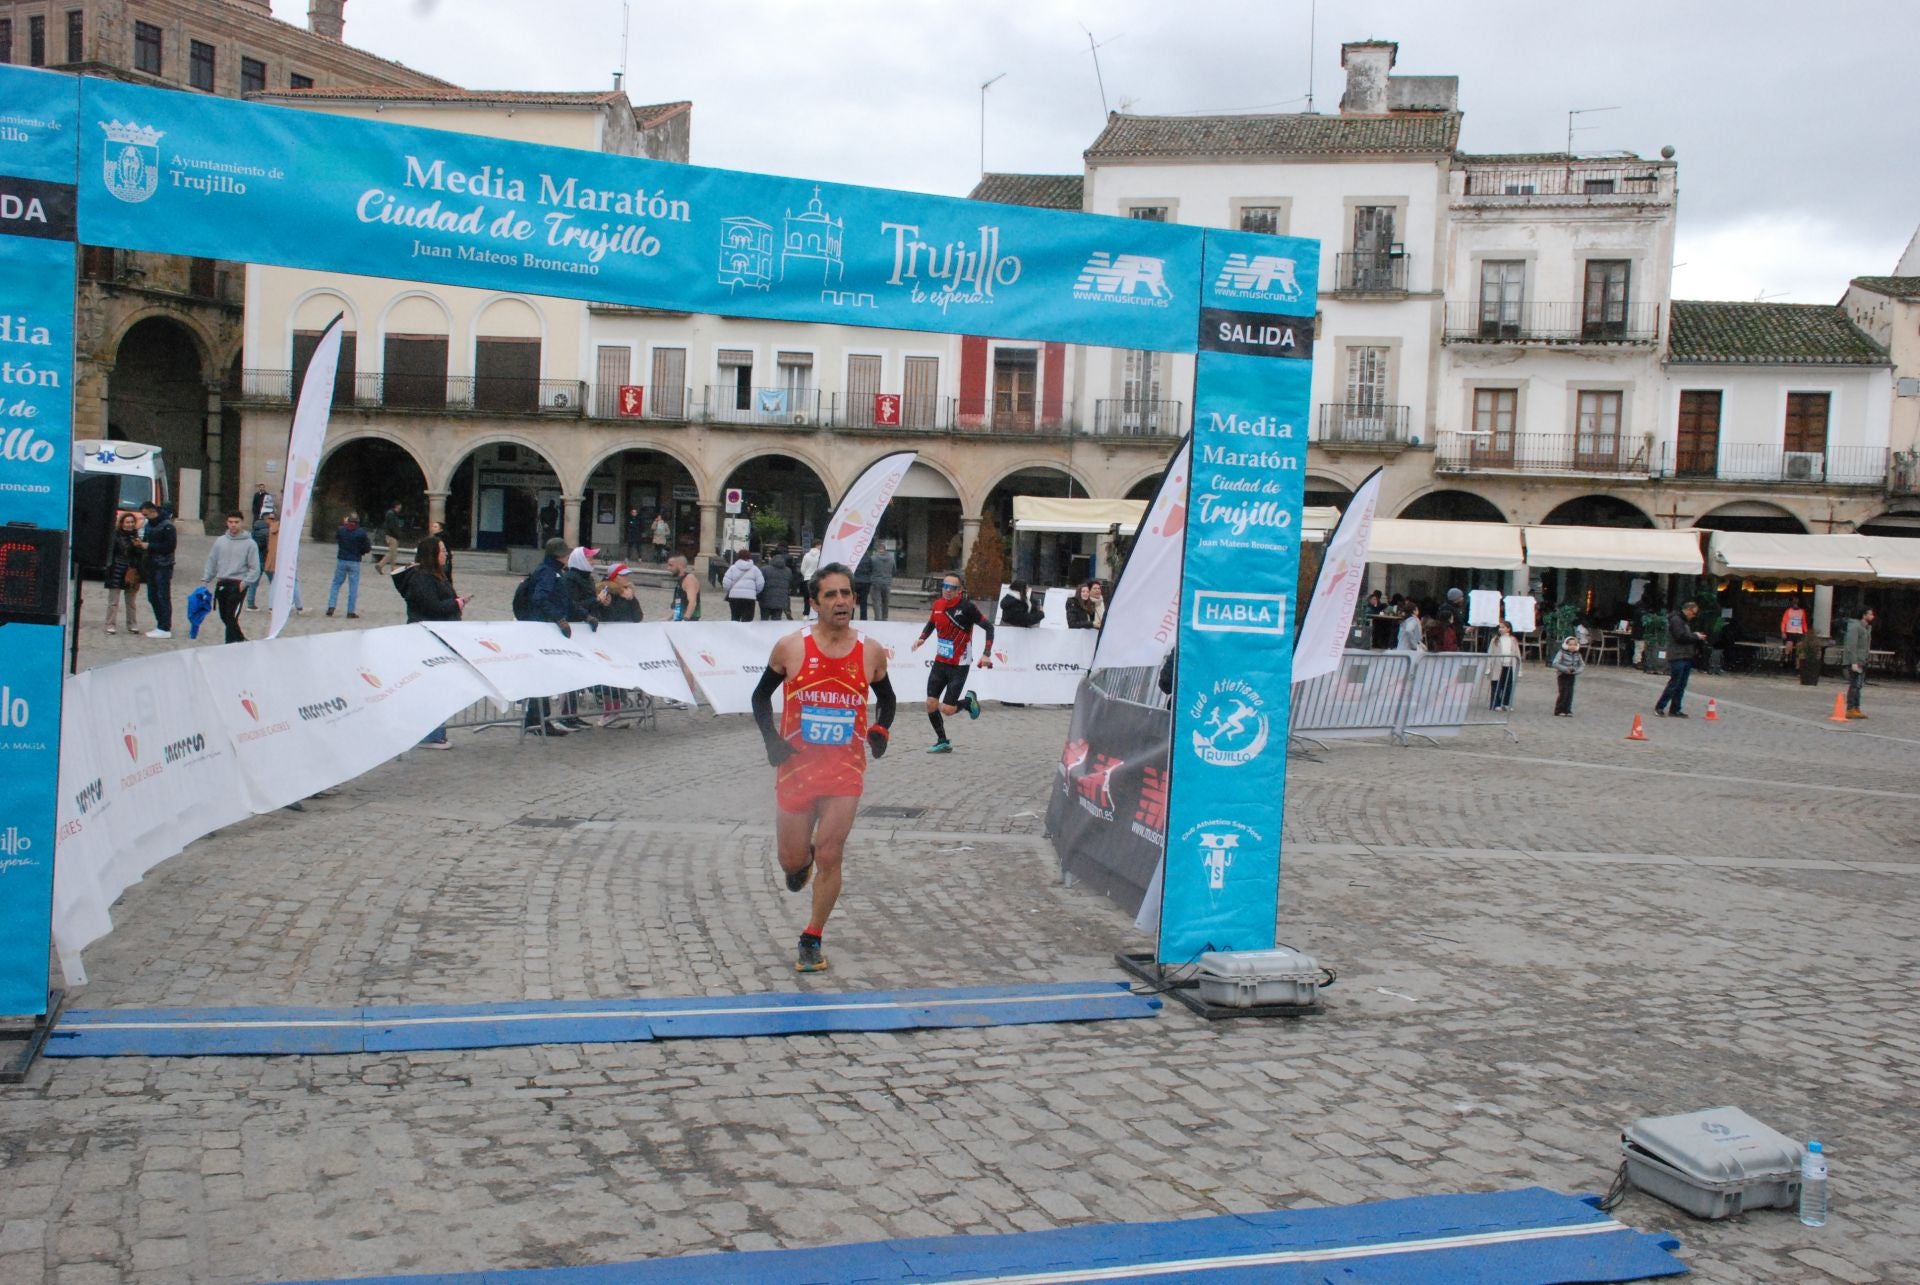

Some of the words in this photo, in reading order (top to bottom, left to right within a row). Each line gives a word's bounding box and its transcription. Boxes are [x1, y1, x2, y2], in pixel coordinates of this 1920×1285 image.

[0, 115, 45, 128] amiento
[48, 119, 62, 130] de
[1, 126, 29, 143] illo
[171, 154, 265, 178] Ayuntamiento
[267, 167, 285, 180] de
[170, 170, 247, 196] Trujillo
[403, 155, 527, 202] Media
[537, 174, 692, 222] Maratón
[1, 197, 47, 223] DA
[356, 189, 486, 236] Ciudad
[490, 210, 536, 241] de
[544, 212, 661, 262] Trujillo
[411, 240, 452, 259] Juan
[457, 245, 518, 266] Mateos
[523, 253, 600, 276] Broncano
[881, 221, 1022, 297] Trujillo
[911, 281, 927, 303] te
[1073, 290, 1169, 308] www.musicrun.es
[1214, 286, 1298, 303] www.musicrun.es
[0, 315, 52, 346] dia
[1218, 322, 1295, 348] SALIDA
[3, 362, 60, 388] tón
[9, 400, 39, 418] de
[1207, 412, 1293, 439] Media
[1202, 444, 1297, 471] Maratón
[0, 483, 50, 493] roncano
[1211, 473, 1261, 494] Ciudad
[1262, 476, 1282, 494] de
[1198, 493, 1292, 536] Trujillo
[1198, 538, 1218, 547] Juan
[1220, 539, 1250, 548] Mateos
[1251, 540, 1289, 551] Broncano
[1206, 602, 1271, 623] HABLA
[1190, 691, 1208, 718] Club
[1213, 678, 1264, 706] Atletismo
[809, 722, 844, 741] 579
[1197, 745, 1251, 761] TRUJILLO
[0, 827, 31, 856] illo
